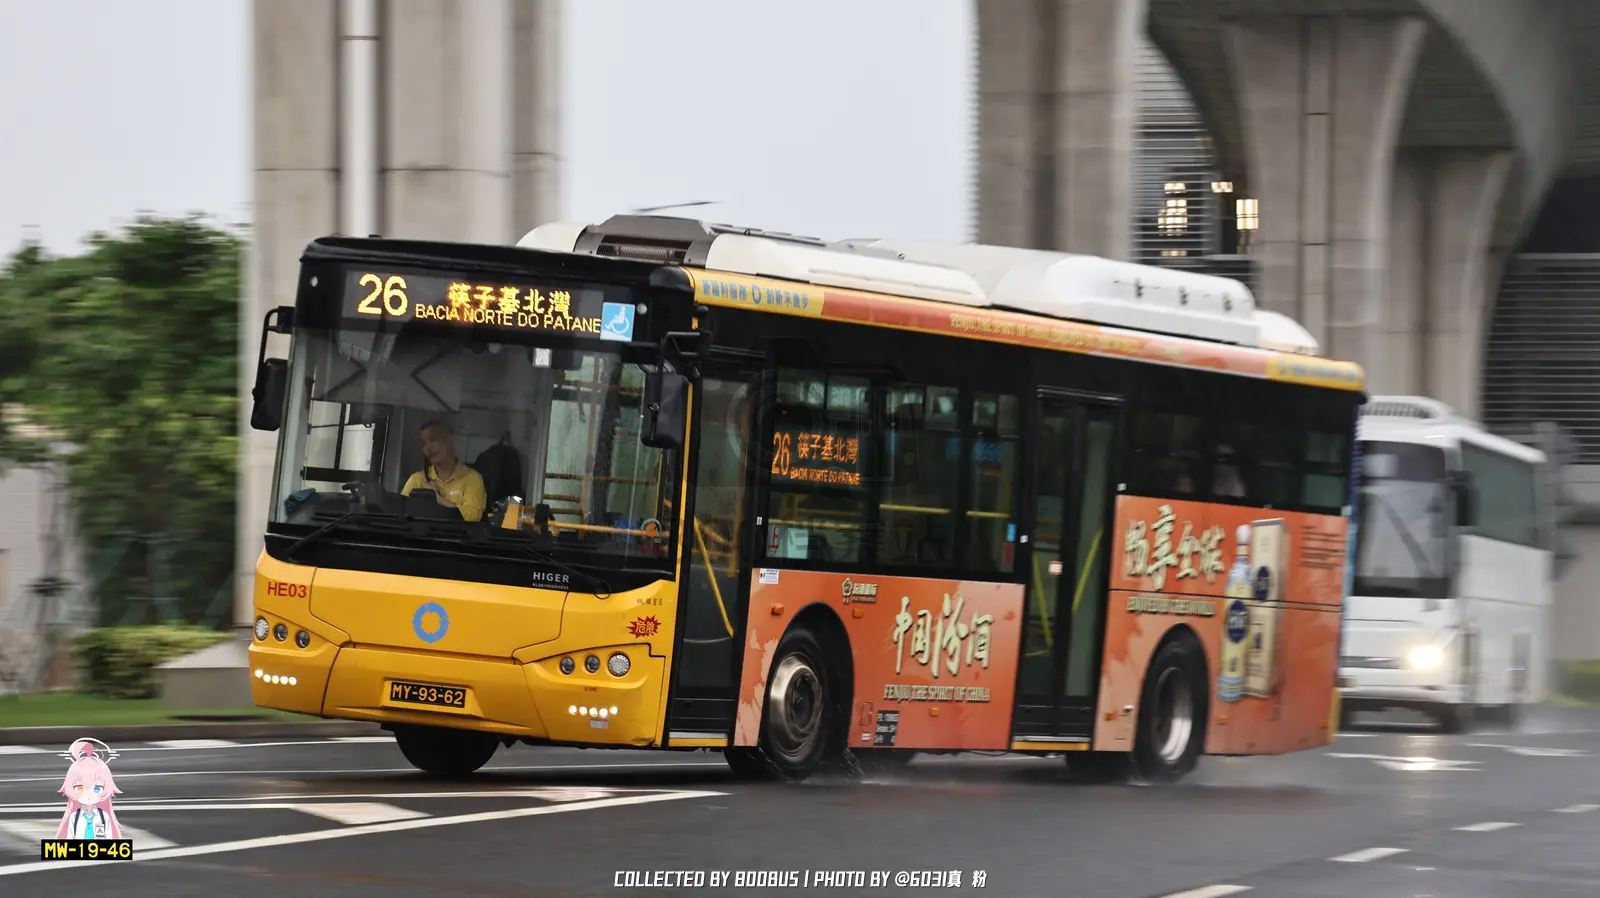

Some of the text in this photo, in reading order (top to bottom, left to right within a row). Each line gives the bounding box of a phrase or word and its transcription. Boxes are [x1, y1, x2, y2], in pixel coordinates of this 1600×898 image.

[357, 273, 408, 316] 26
[448, 282, 572, 316] 筷子基北灣
[415, 304, 600, 333] BACIA NORTE DO PATANE
[771, 431, 791, 476] 26
[797, 431, 859, 465] 筷子基北灣
[267, 581, 307, 599] HE03
[532, 571, 570, 584] HIGER
[392, 683, 464, 706] MY-93-62
